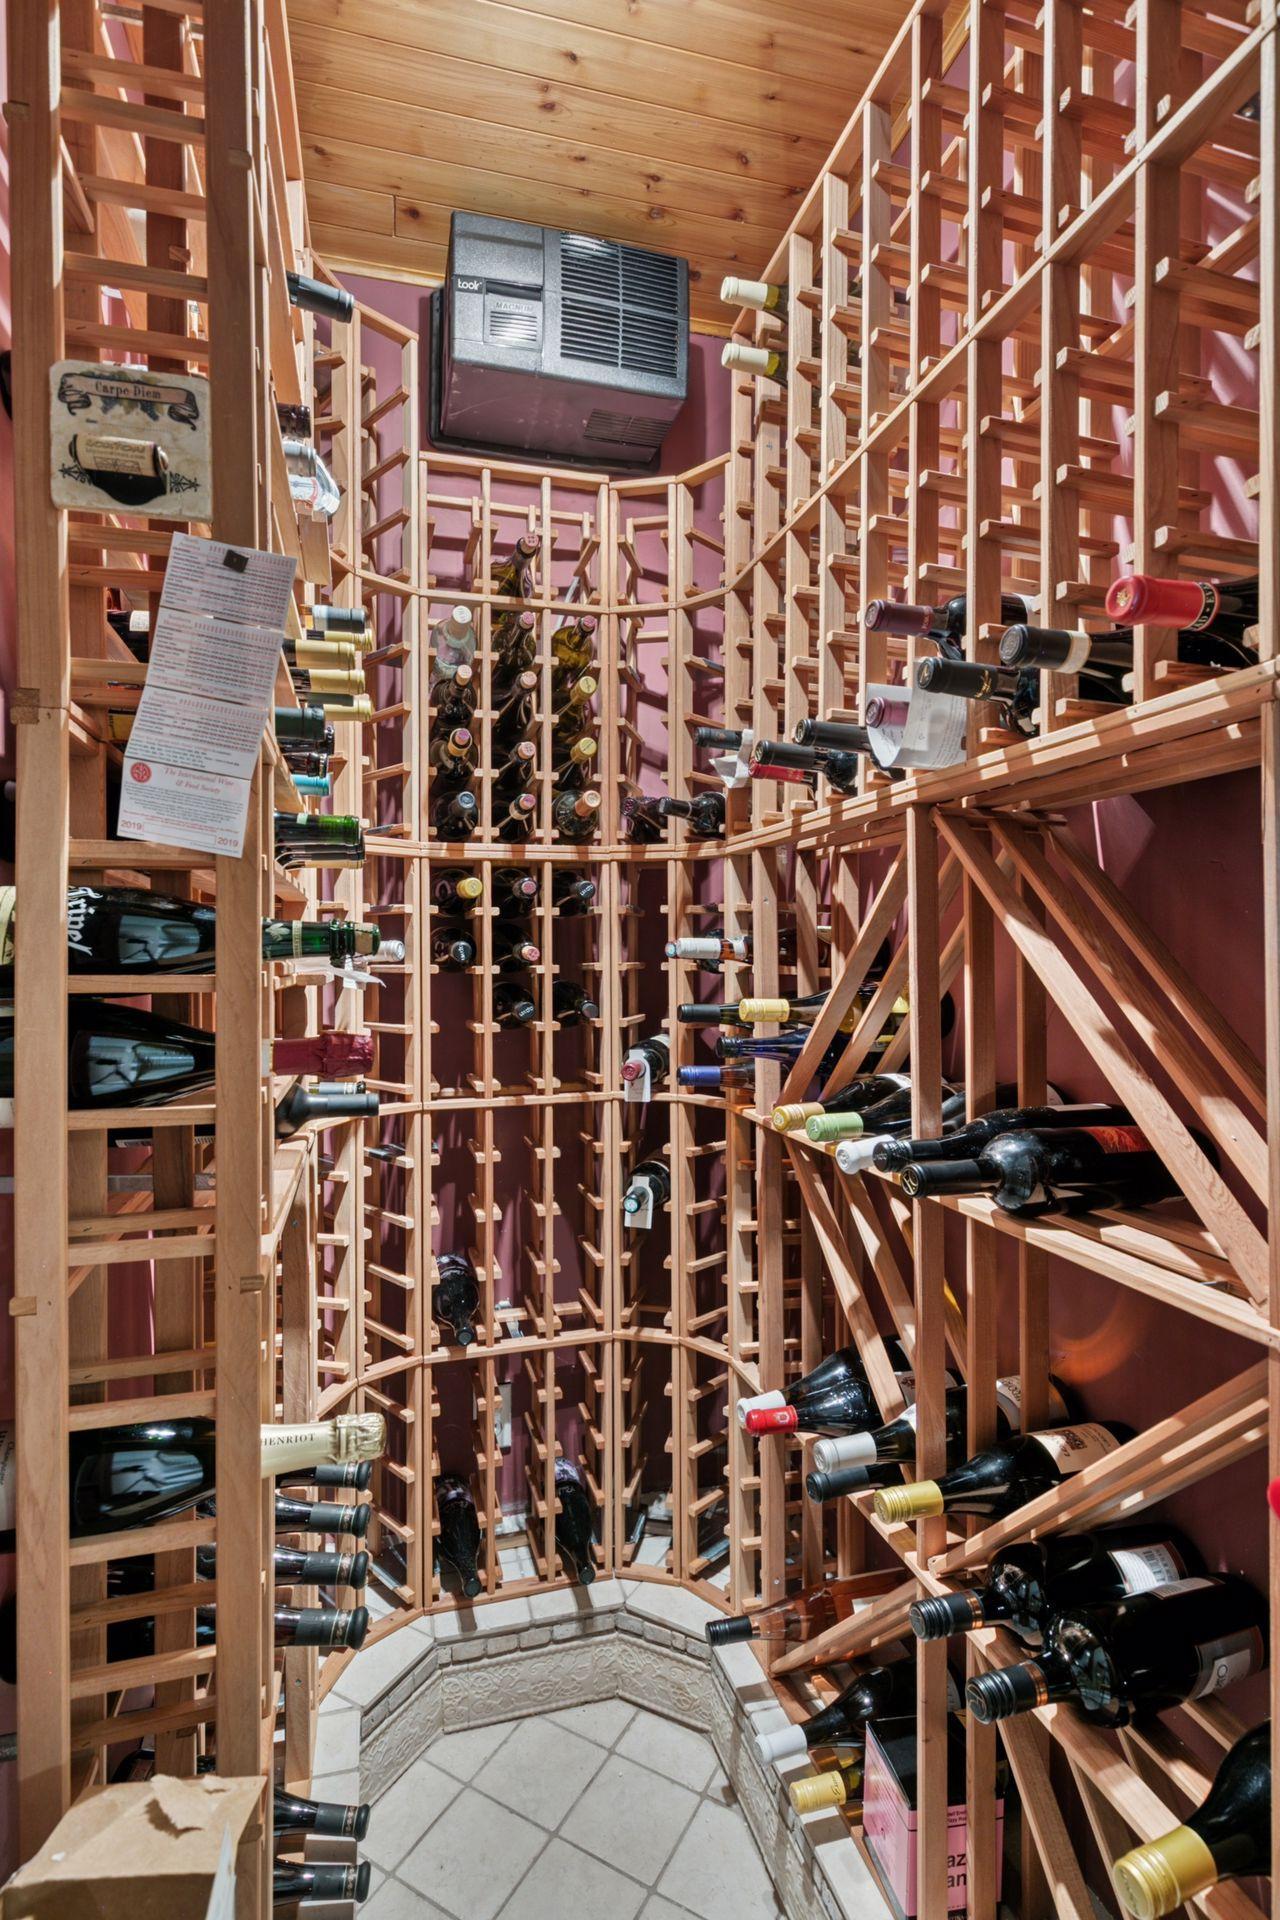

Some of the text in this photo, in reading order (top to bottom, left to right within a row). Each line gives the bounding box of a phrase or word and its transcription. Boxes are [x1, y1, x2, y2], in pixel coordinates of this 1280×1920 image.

[95, 381, 162, 400] Carpe Diem
[164, 766, 235, 787] The International Wine
[185, 781, 200, 790] Food
[201, 783, 221, 794] Society
[120, 819, 143, 831] 2019
[217, 836, 239, 848] 2019
